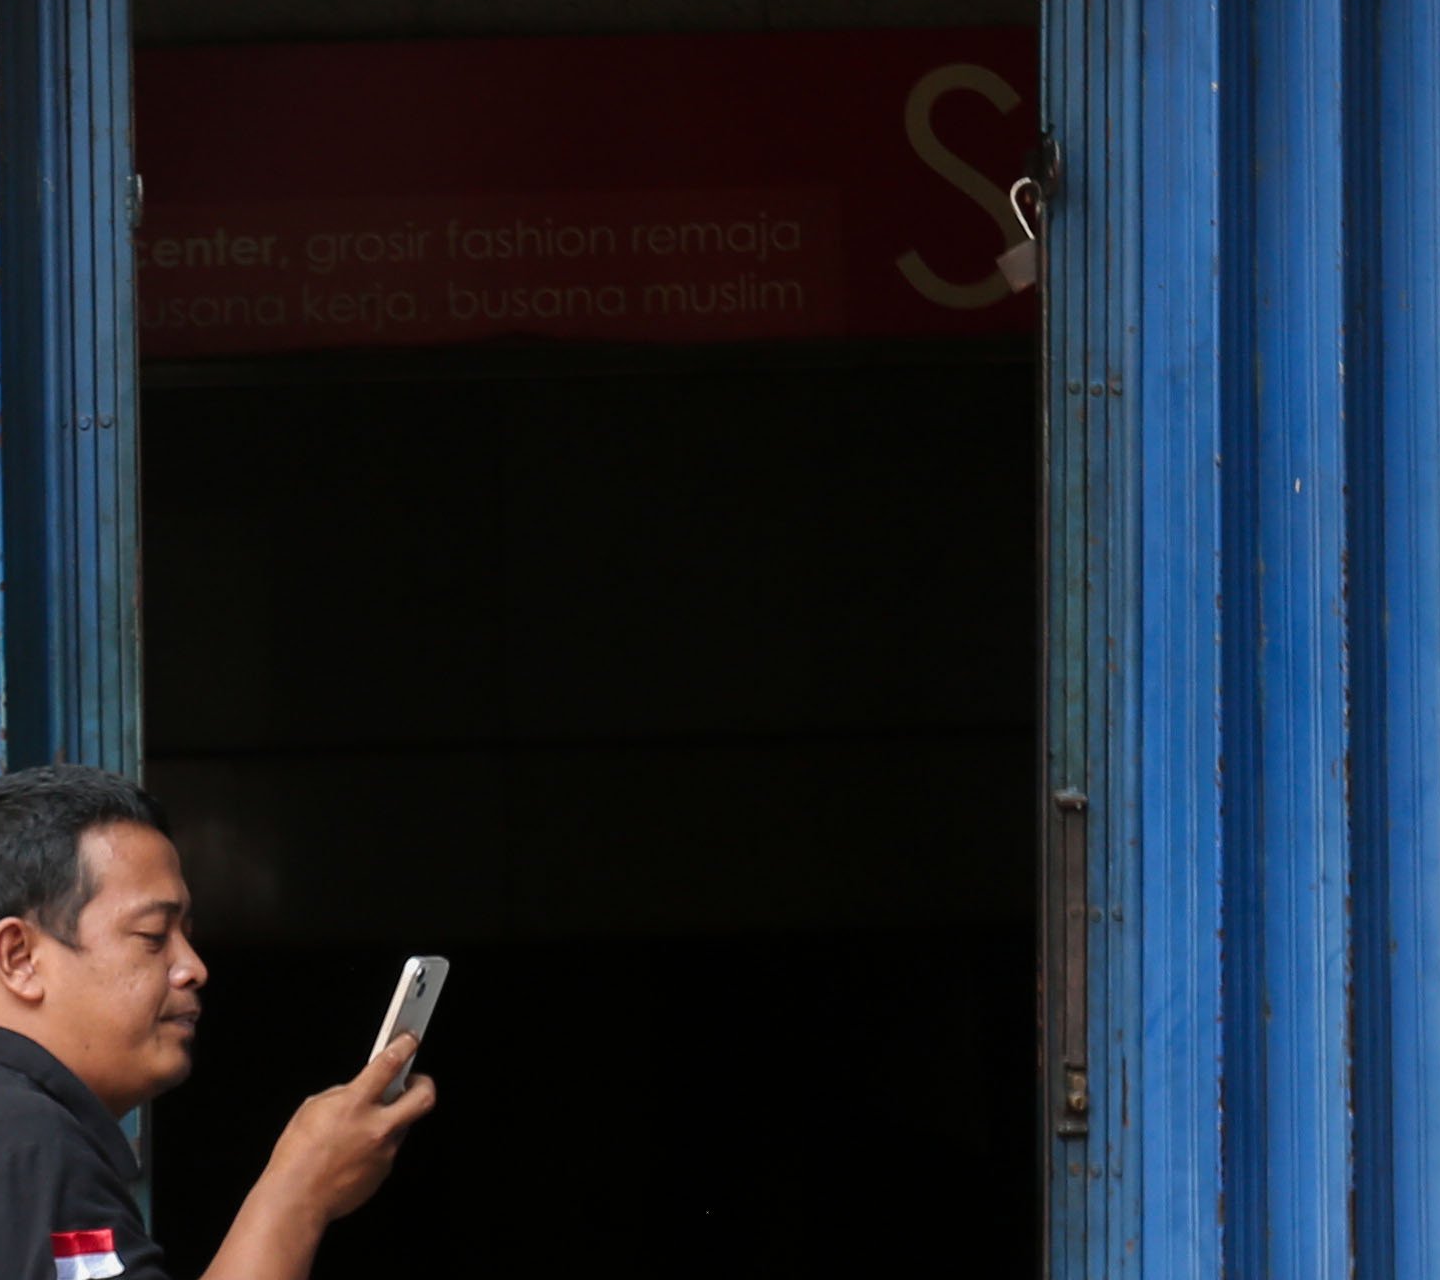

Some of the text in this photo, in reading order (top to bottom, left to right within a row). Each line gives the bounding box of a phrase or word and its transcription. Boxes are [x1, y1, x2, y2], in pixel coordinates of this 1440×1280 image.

[305, 221, 430, 275] grosir
[446, 216, 618, 261] fashion
[629, 211, 804, 264] remaja
[140, 292, 287, 330] usana
[446, 279, 628, 322] busana
[642, 271, 805, 316] muslim
